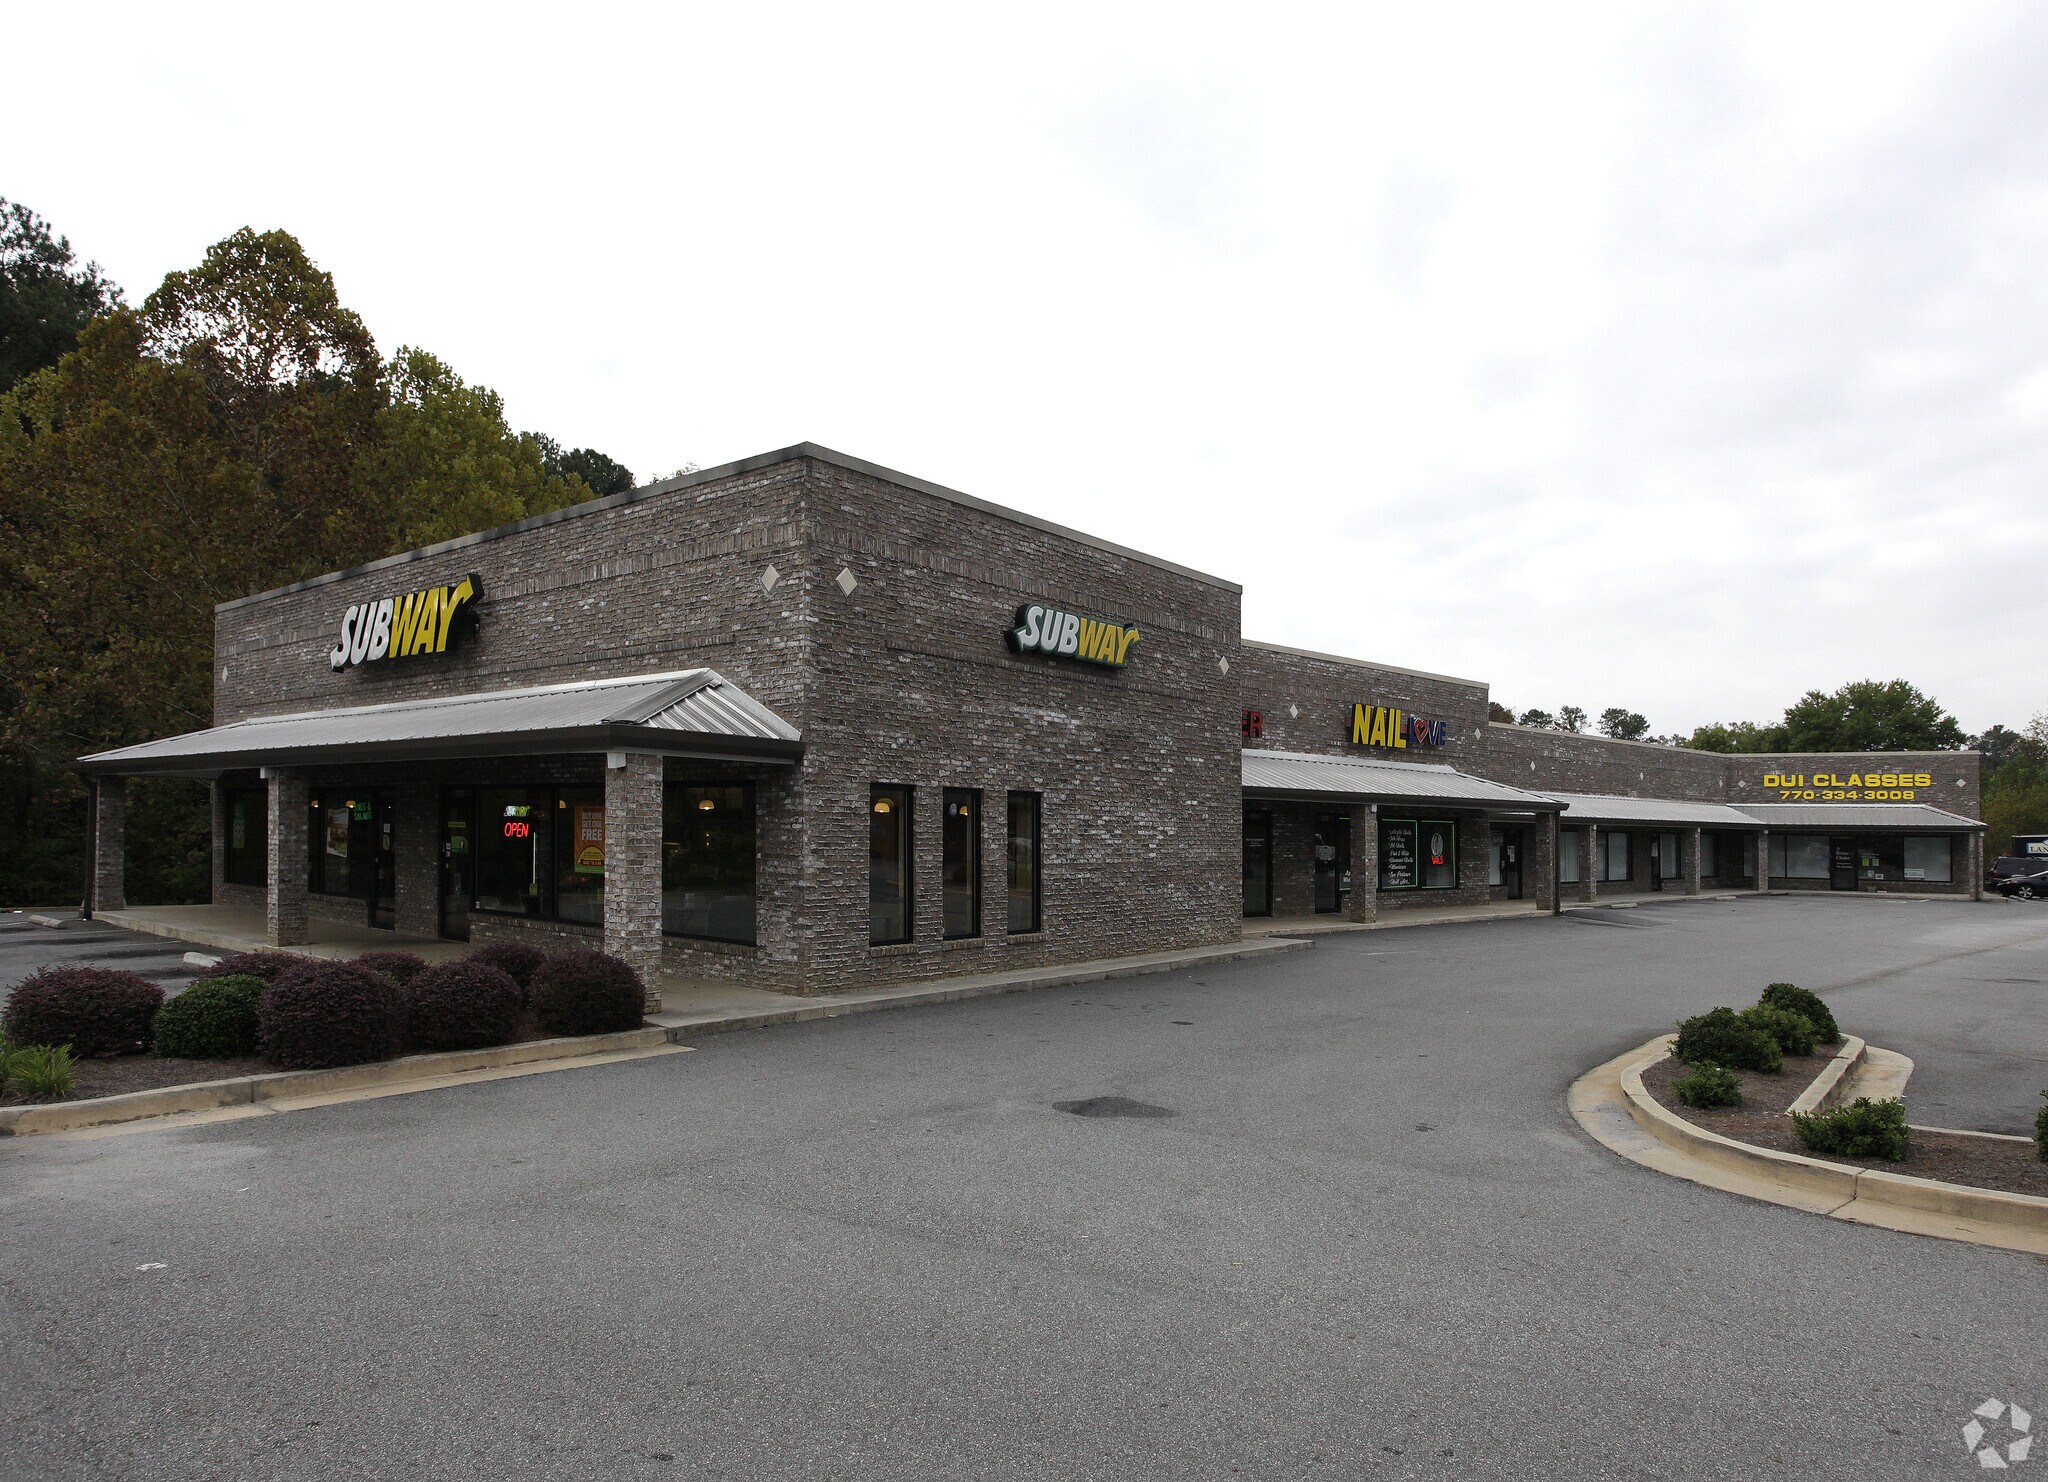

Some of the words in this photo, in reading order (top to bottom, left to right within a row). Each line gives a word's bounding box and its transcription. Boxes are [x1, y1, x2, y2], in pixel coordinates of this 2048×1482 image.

[330, 575, 475, 669] SUBWAY
[1017, 605, 1140, 664] SUBWAY
[1352, 703, 1407, 749] NAIL
[1763, 774, 1804, 787] DUI
[1813, 773, 1932, 788] CLASSES
[1779, 790, 1915, 801] 770-334-3008
[581, 812, 591, 820] BUY
[592, 812, 603, 820] ONE
[504, 822, 530, 838] OPEN
[581, 820, 591, 828] GET
[592, 820, 603, 828] ONE
[581, 829, 603, 841] FREE
